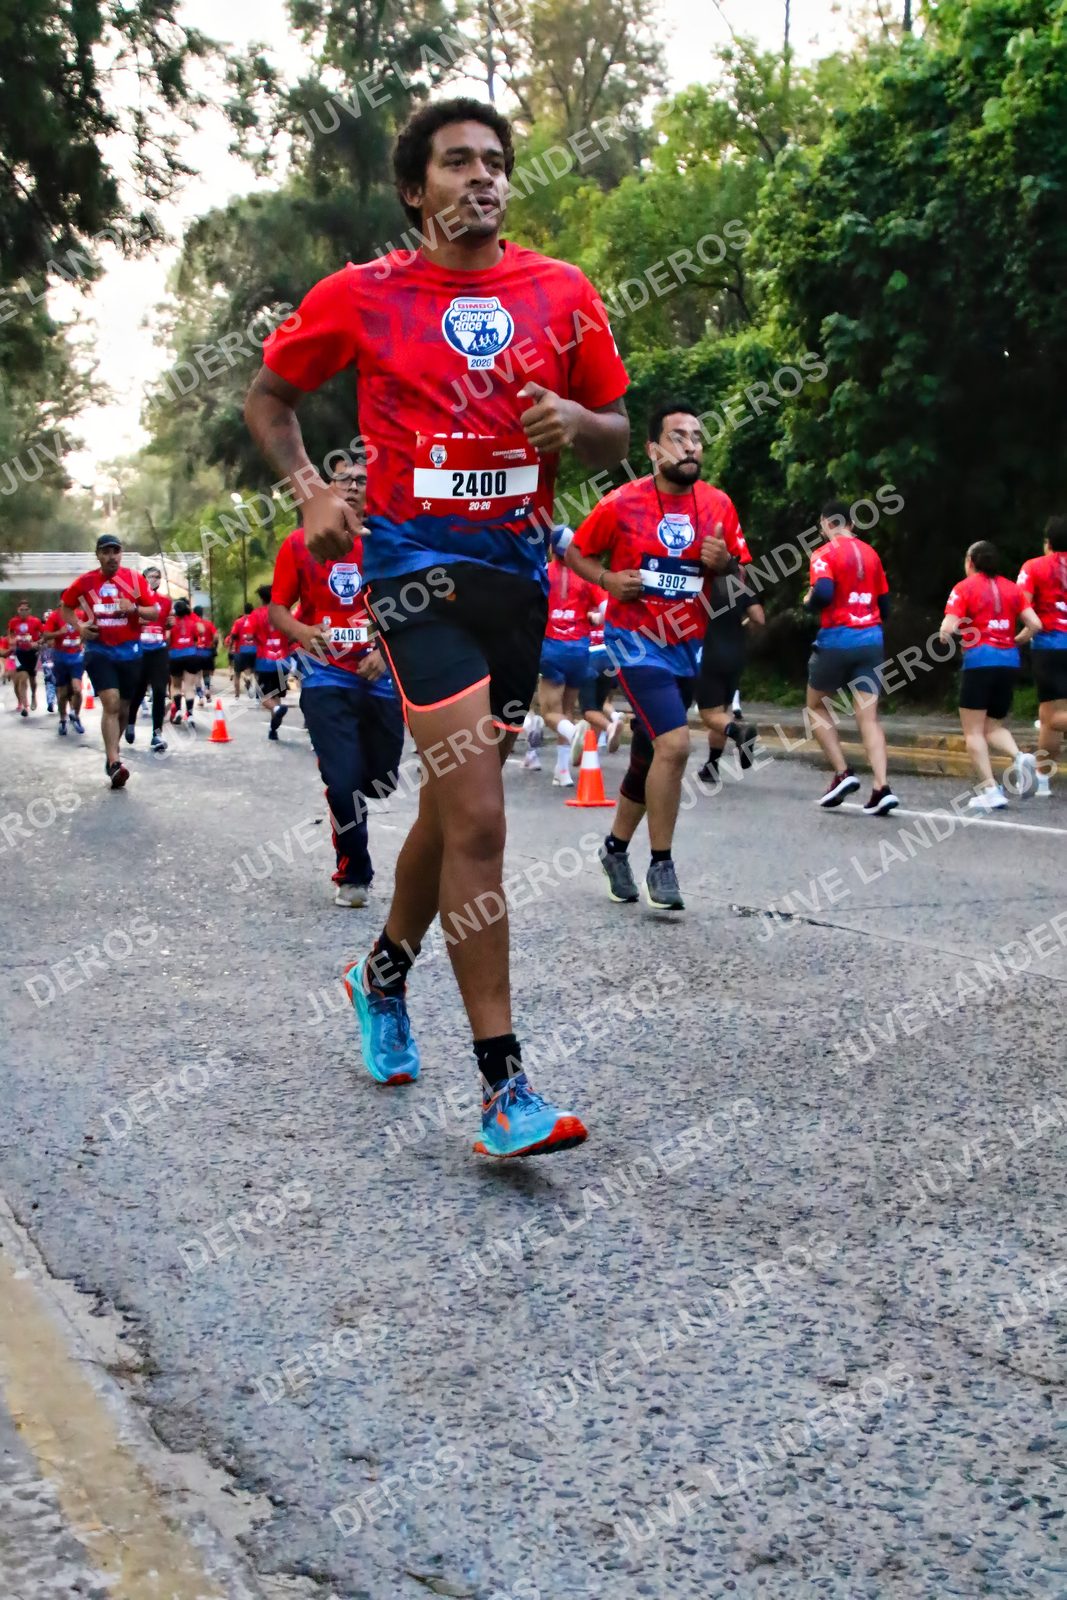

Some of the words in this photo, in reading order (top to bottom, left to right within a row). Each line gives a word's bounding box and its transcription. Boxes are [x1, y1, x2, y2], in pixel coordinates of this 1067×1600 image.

[460, 311, 495, 322] Global
[453, 320, 482, 331] Race
[452, 470, 507, 497] 2400
[468, 501, 492, 511] 20-26
[514, 507, 526, 516] 5K
[657, 573, 688, 590] 3902
